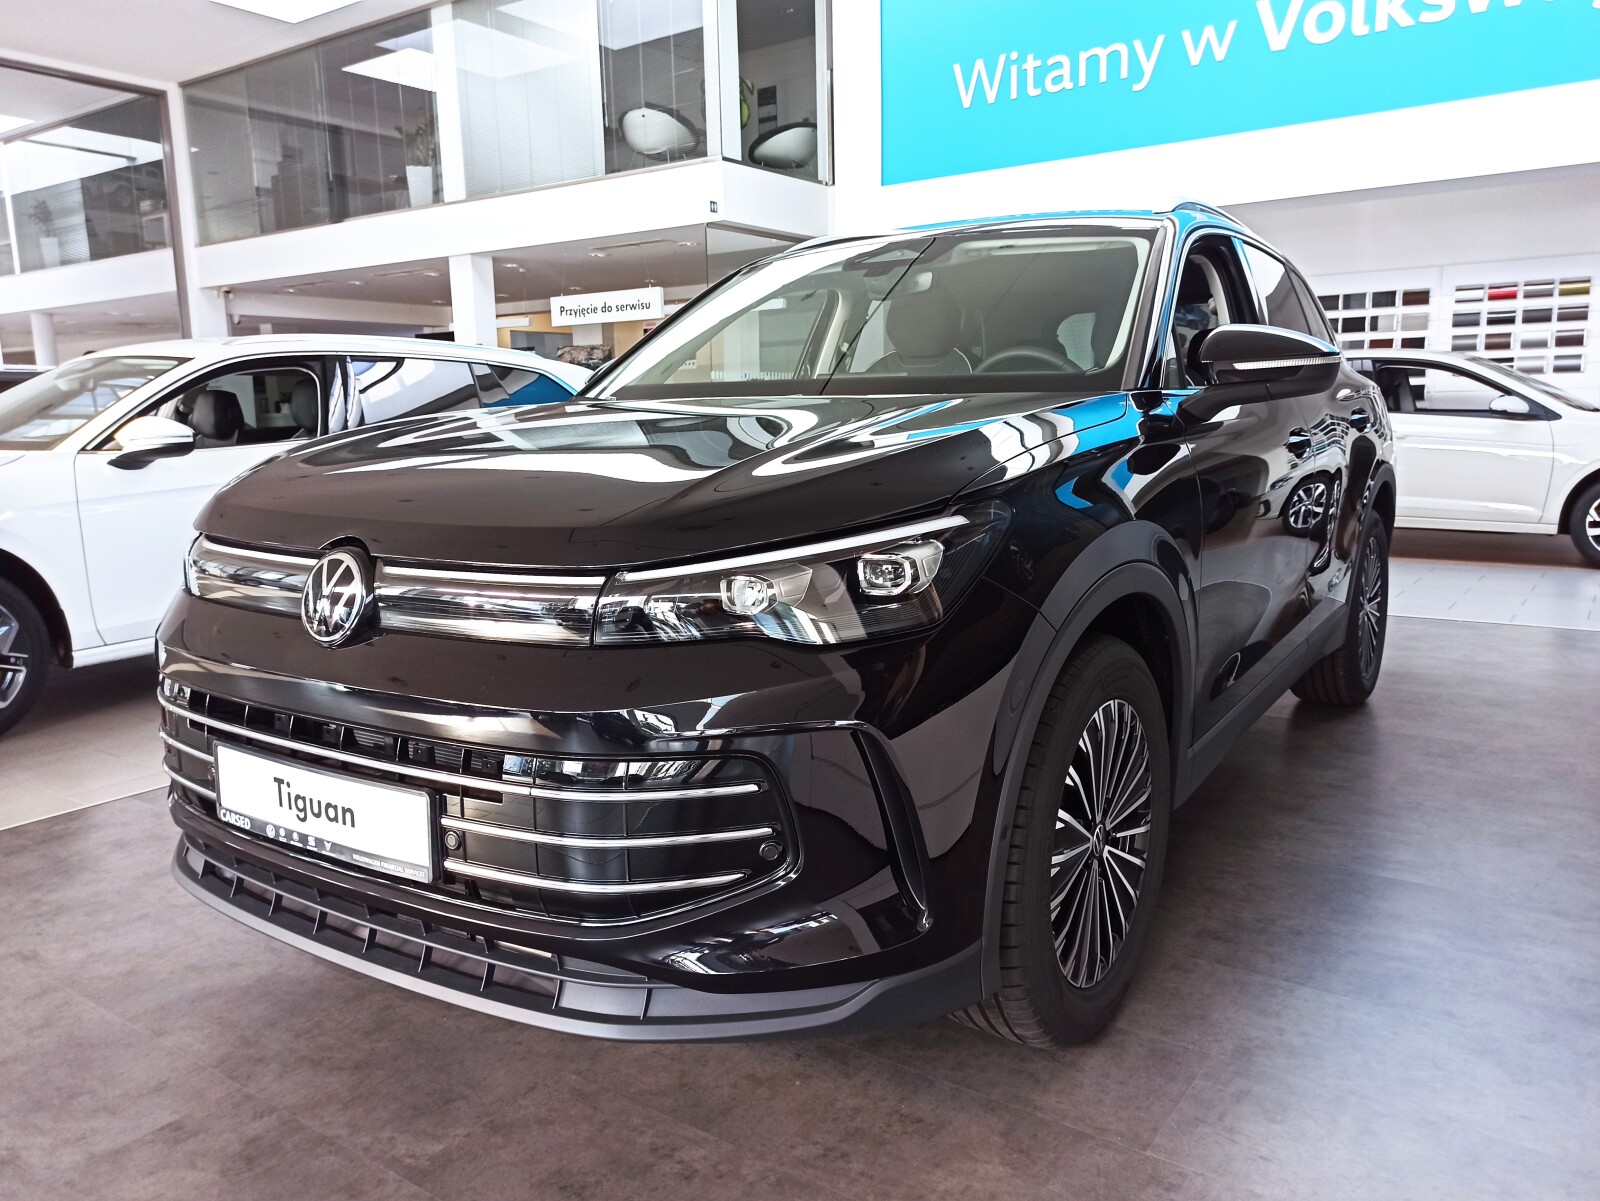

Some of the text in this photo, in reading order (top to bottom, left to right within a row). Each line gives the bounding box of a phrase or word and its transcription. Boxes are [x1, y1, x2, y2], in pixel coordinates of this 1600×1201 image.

[953, 34, 1165, 109] Witamy
[1181, 20, 1238, 67] w
[560, 299, 651, 318] Przyjęcie do serwisu
[220, 808, 251, 830] CARSED
[273, 776, 356, 828] Tiguan
